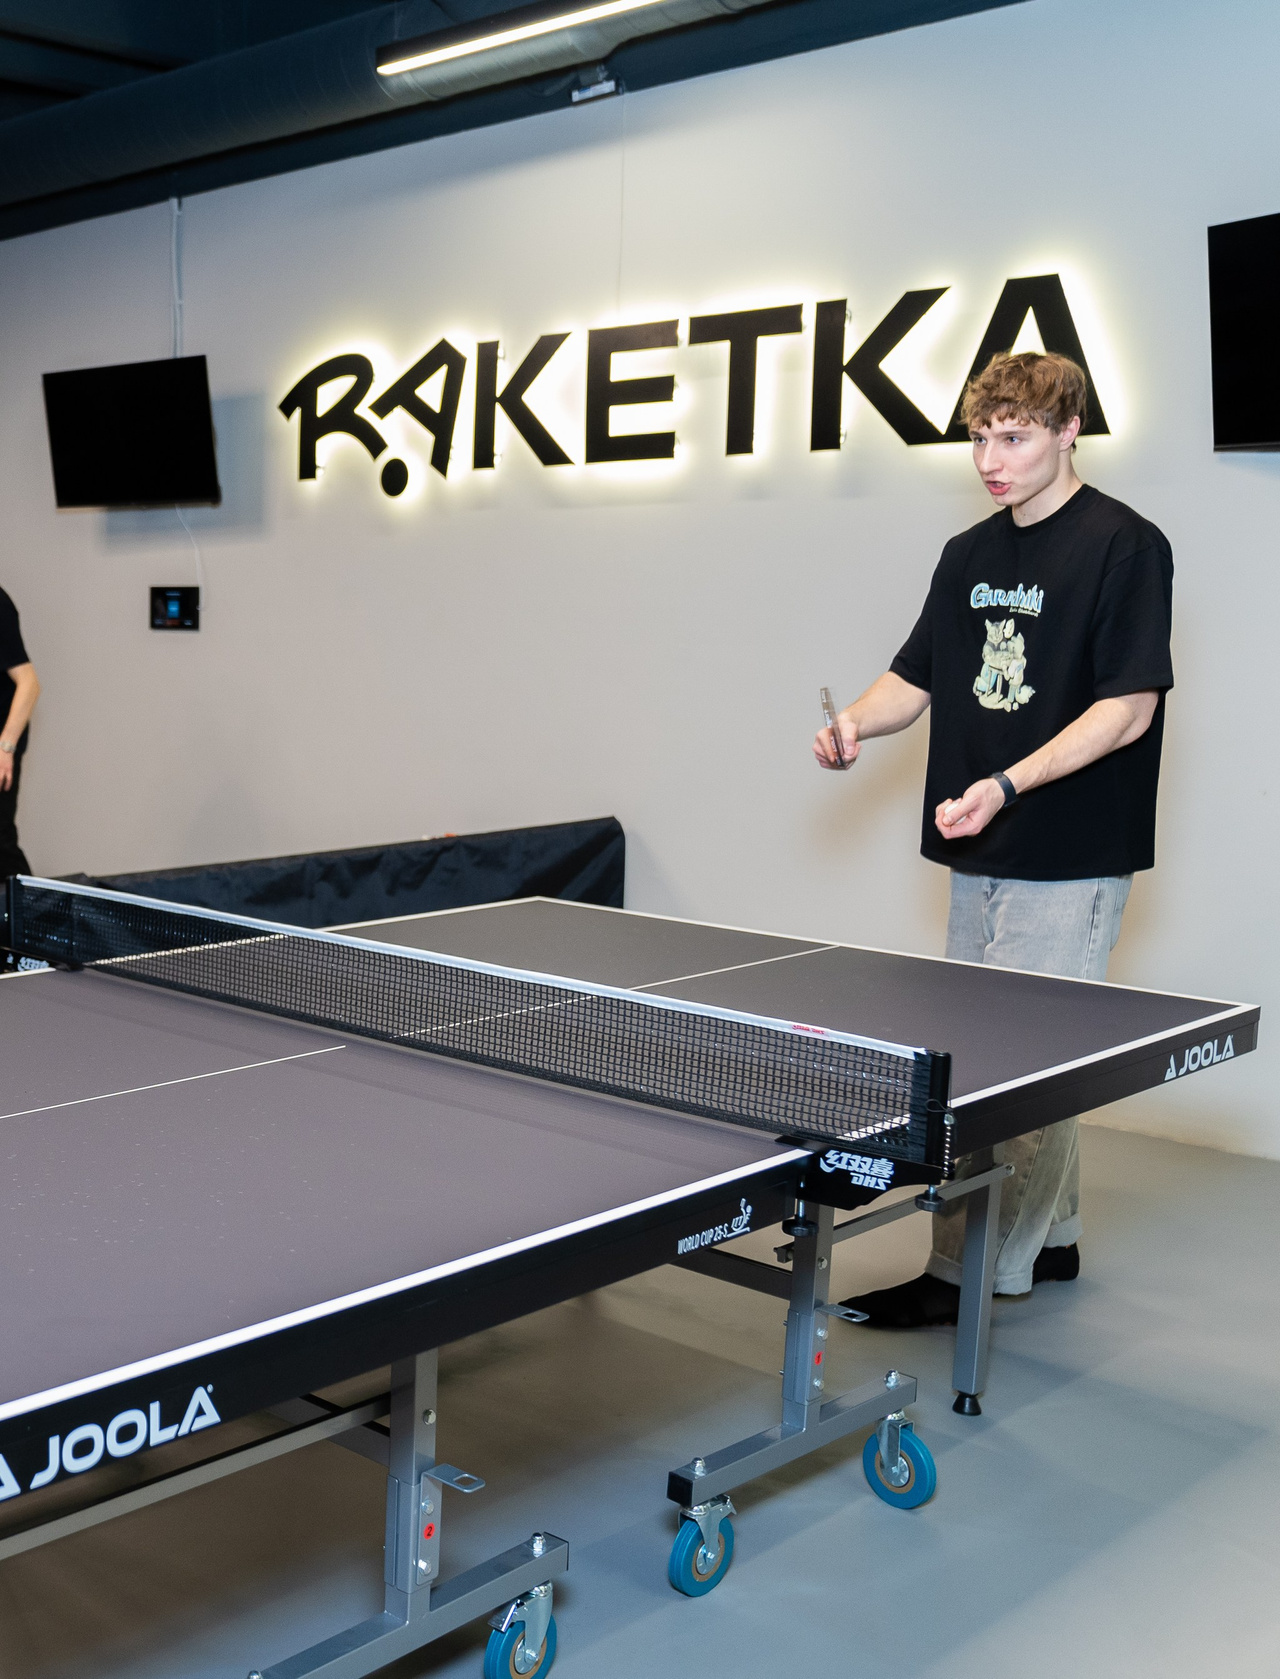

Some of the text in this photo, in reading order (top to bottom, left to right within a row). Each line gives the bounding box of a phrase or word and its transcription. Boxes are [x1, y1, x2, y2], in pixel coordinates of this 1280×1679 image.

[279, 273, 1111, 498] RAKETKA
[1178, 1034, 1235, 1076] JOOLA
[849, 1172, 892, 1191] DHS
[677, 1233, 700, 1255] WORLD
[700, 1228, 714, 1247] CUP
[29, 1386, 221, 1490] JOOLA
